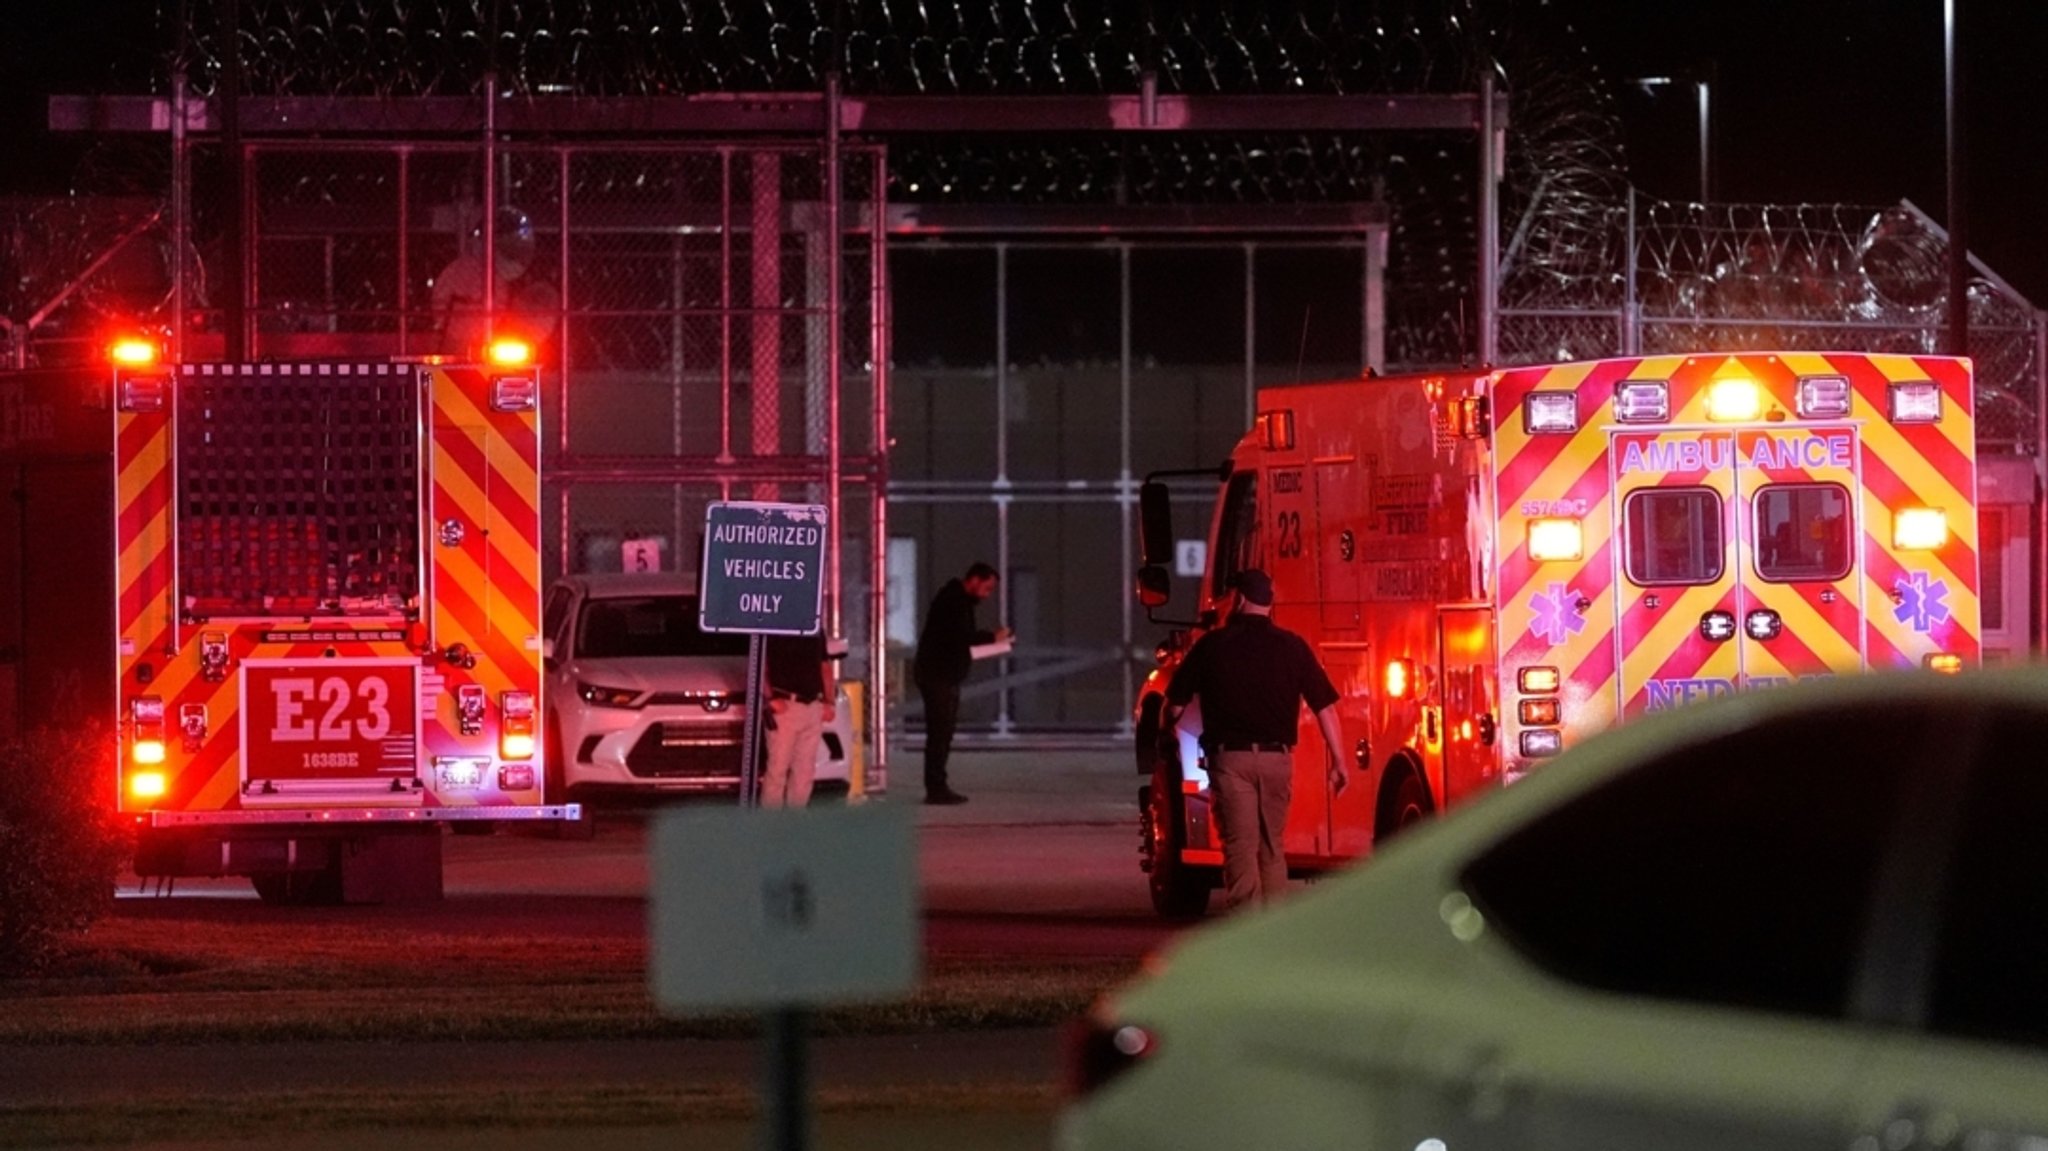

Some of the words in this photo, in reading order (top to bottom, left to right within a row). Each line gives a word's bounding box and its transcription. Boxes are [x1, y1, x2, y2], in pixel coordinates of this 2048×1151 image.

[1620, 437, 1850, 472] AMBULANCE
[714, 524, 818, 546] AUTHORIZED
[1278, 511, 1300, 558] 23
[1387, 511, 1428, 535] FIRE
[636, 549, 648, 571] 5
[724, 558, 805, 580] VEHICLES
[1185, 545, 1198, 569] 6
[739, 593, 782, 614] ONLY
[271, 676, 390, 741] E23
